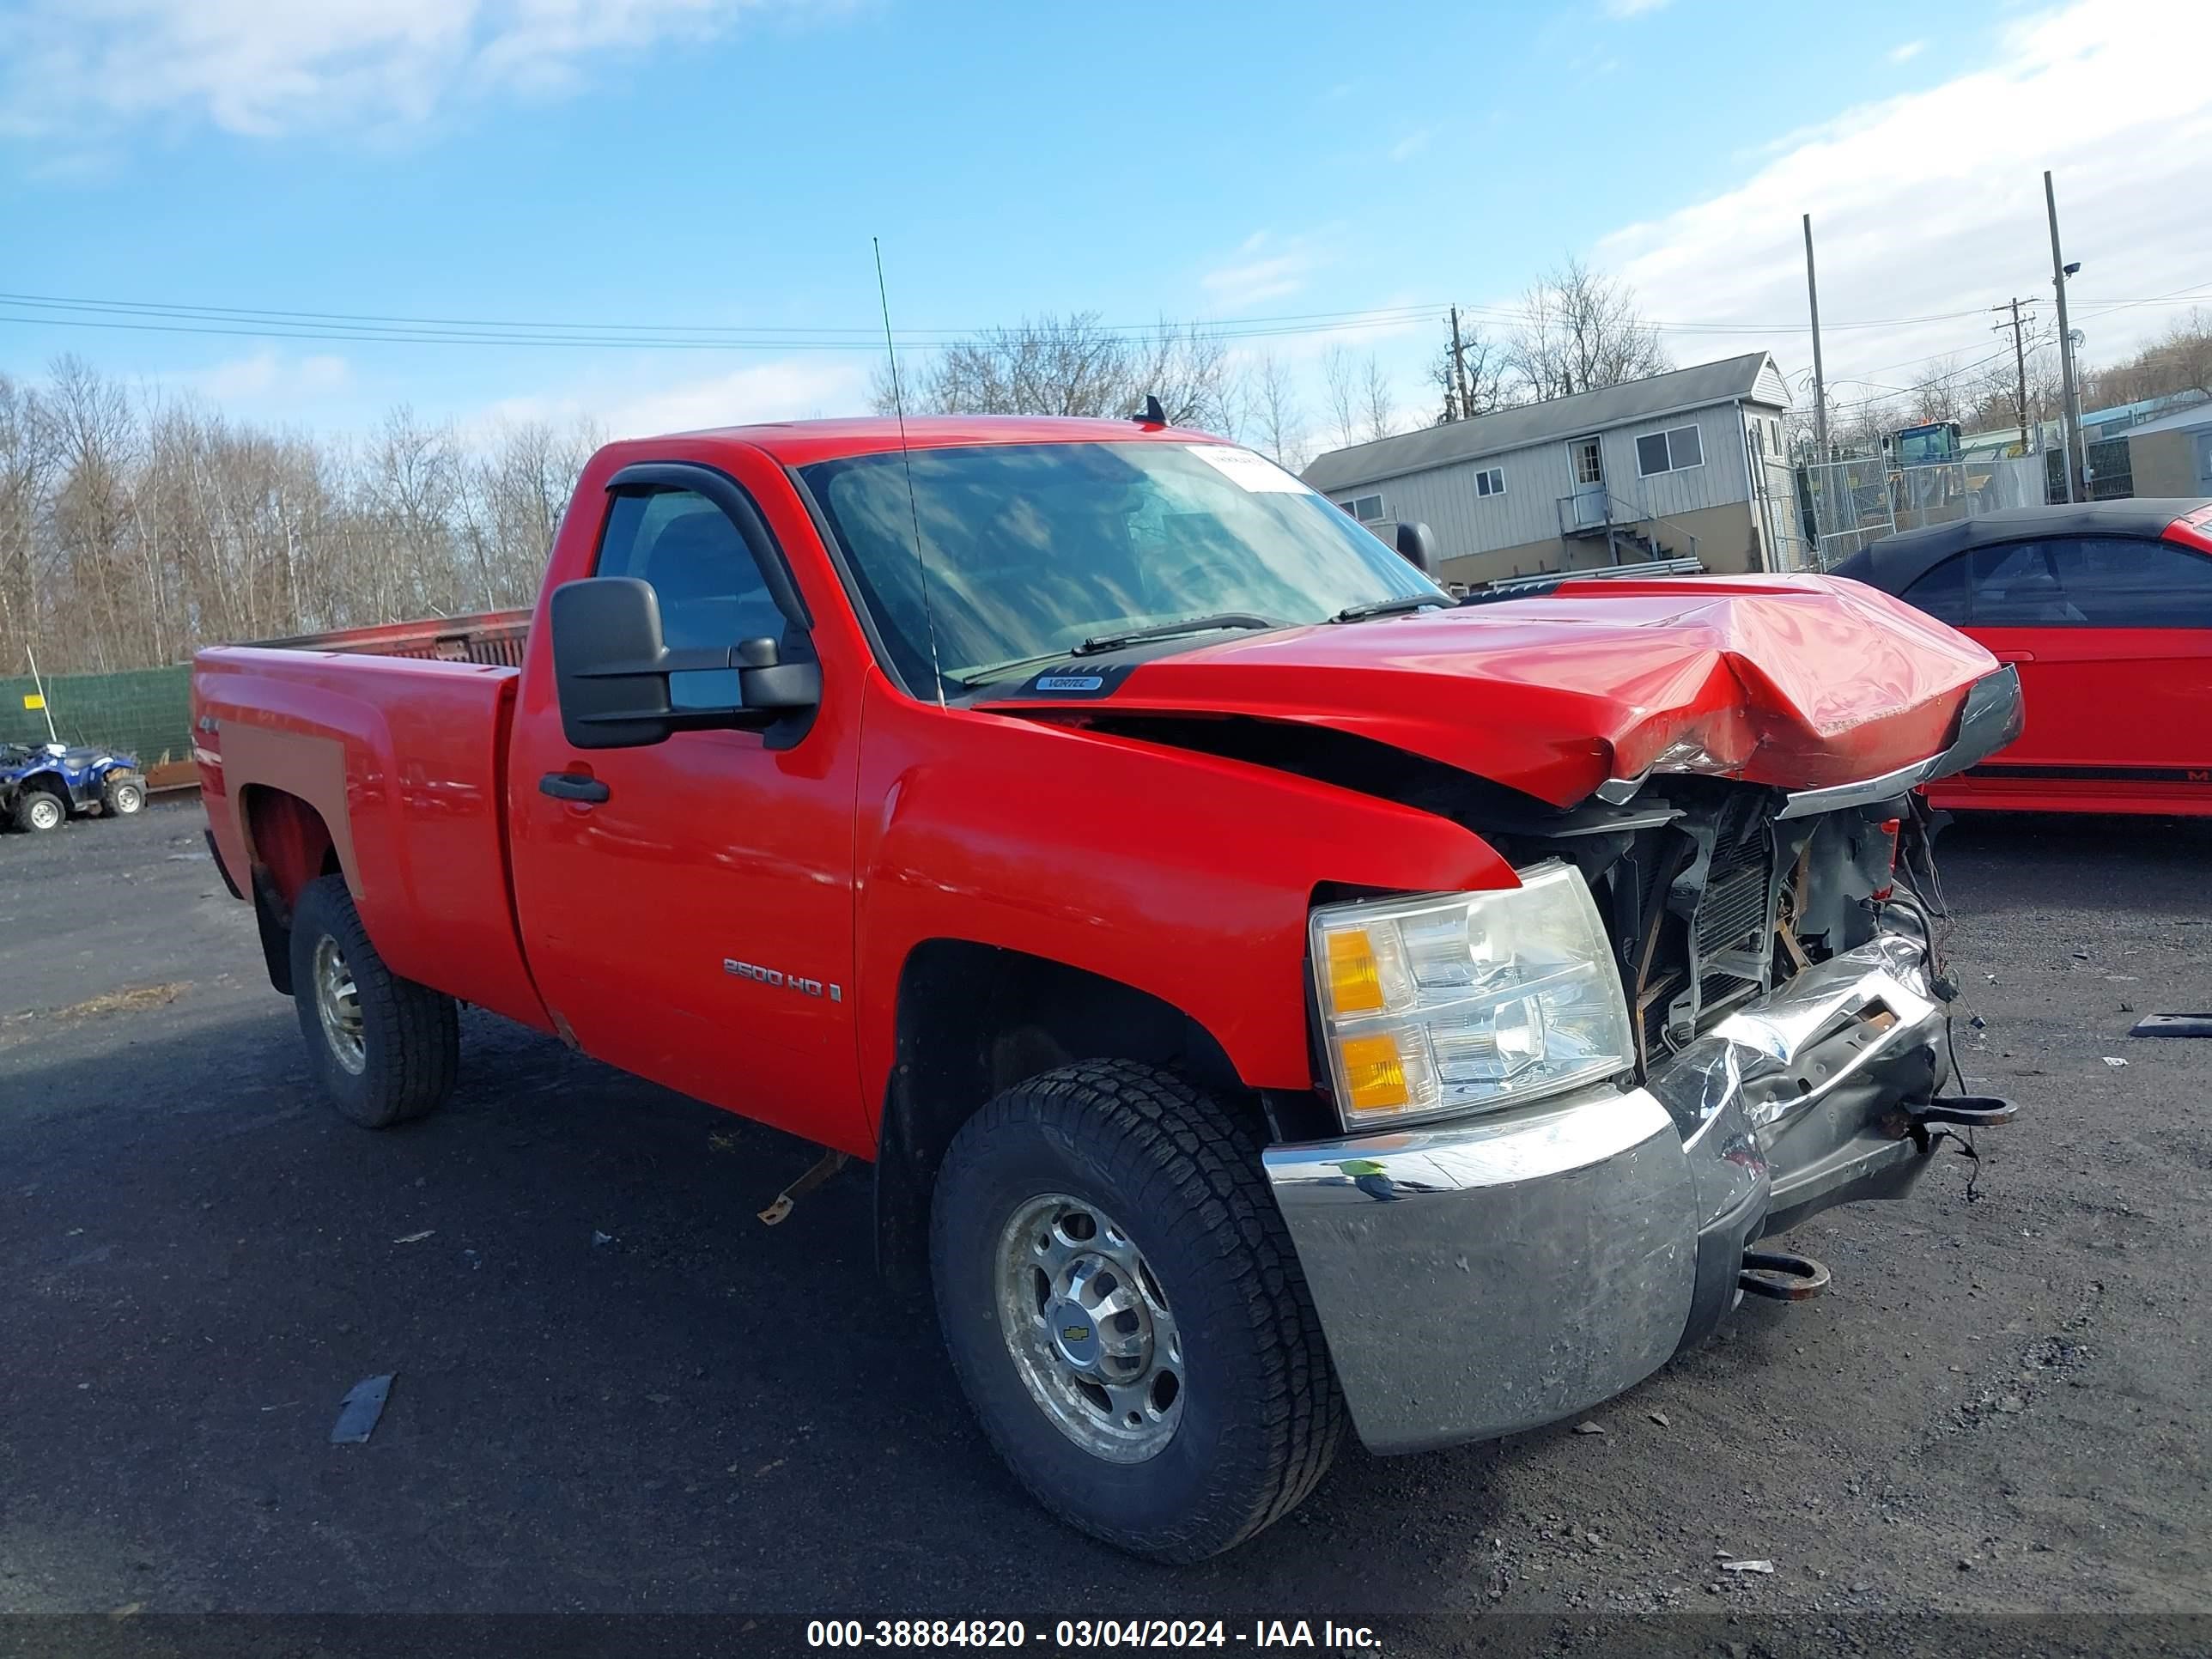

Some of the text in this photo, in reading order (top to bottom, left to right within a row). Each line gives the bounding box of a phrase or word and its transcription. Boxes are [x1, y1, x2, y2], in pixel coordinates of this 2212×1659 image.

[1048, 678, 1090, 688] VORTEC
[724, 958, 822, 996] 2500 HD
